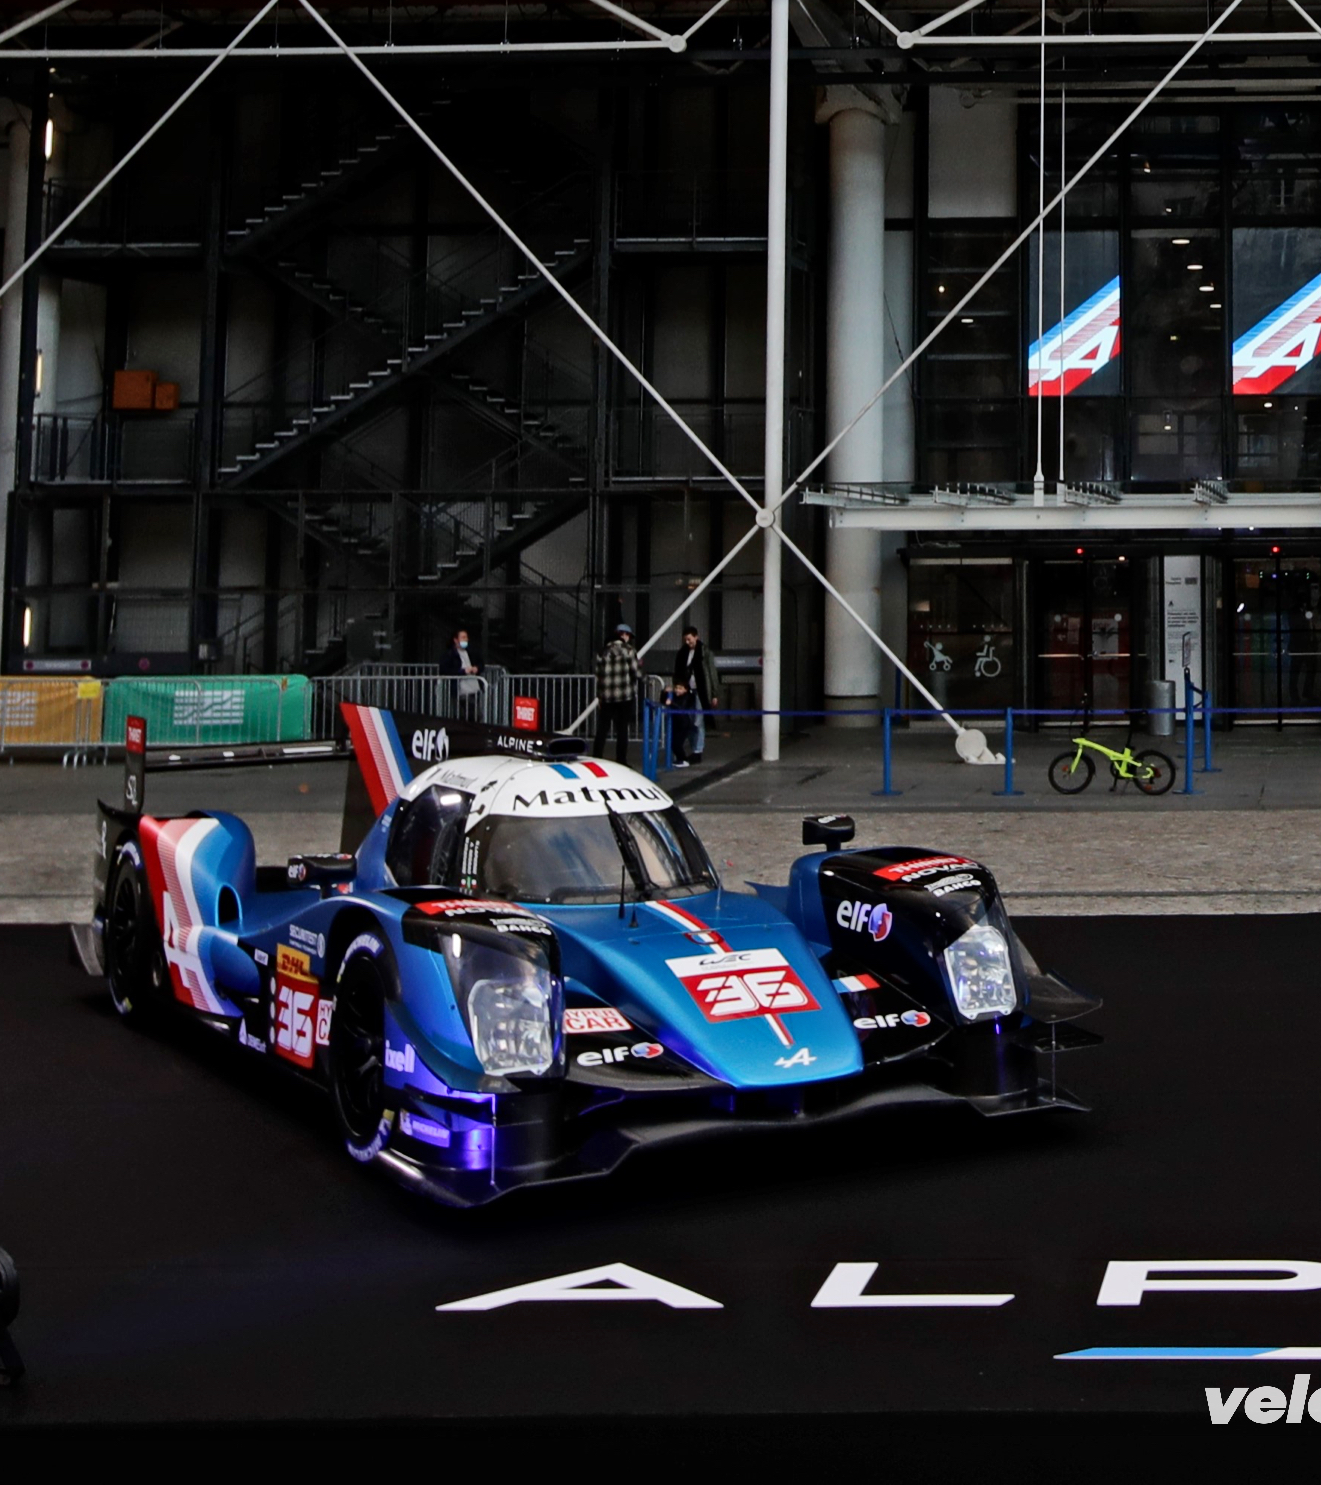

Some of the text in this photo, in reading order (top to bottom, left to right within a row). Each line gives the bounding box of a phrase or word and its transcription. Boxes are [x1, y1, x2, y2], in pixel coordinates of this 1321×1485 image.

[412, 729, 437, 760] elf
[497, 735, 534, 752] ALPINE
[836, 900, 872, 933] elf
[282, 953, 309, 976] DHL
[697, 970, 809, 1016] 36
[277, 986, 315, 1059] 36
[566, 1017, 624, 1031] CAR
[853, 1013, 900, 1029] elf
[576, 1046, 630, 1066] elf
